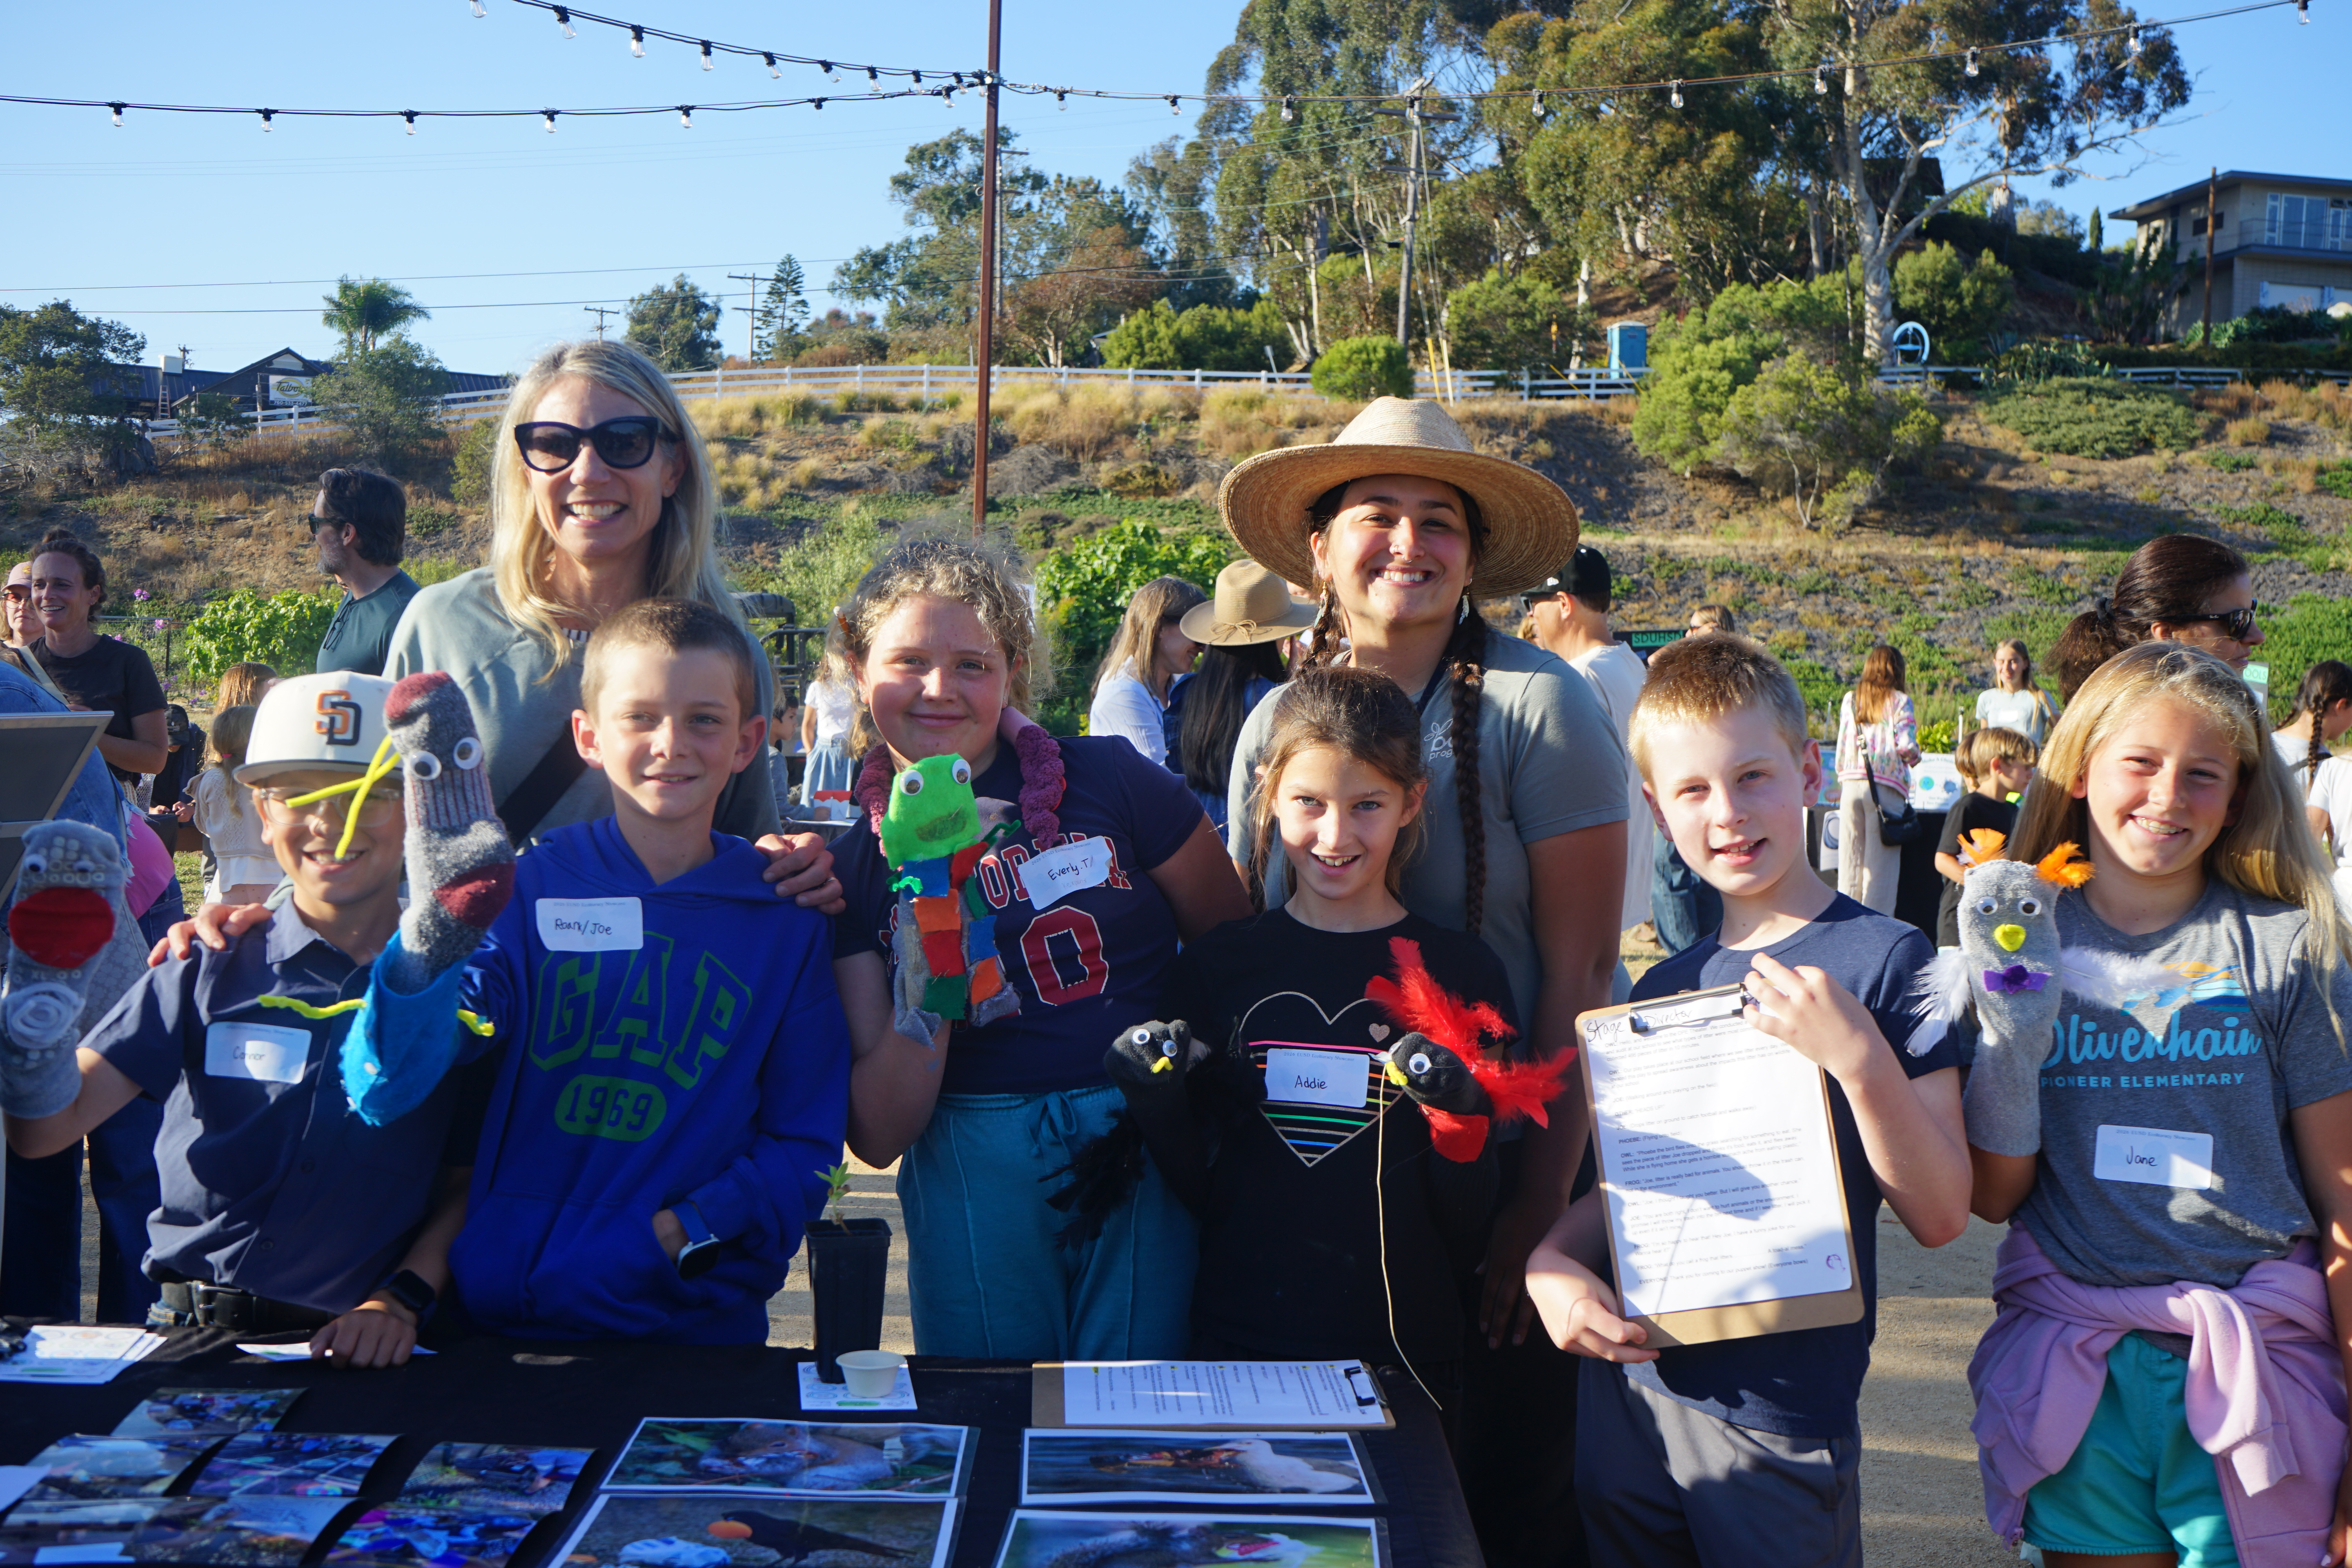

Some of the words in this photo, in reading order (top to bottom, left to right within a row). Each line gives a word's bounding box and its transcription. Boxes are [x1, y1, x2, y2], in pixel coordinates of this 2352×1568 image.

[1634, 630, 1682, 644] SDUHSD
[315, 690, 362, 746] SD
[529, 931, 753, 1090] GAP
[1588, 1020, 1624, 1042] Stage
[1644, 1009, 1692, 1027] Director
[2040, 1010, 2261, 1069] Olivenhain
[1294, 1075, 1328, 1089] Addie
[2041, 1076, 2111, 1088] PIONEER
[2121, 1073, 2245, 1087] ELEMENTARY
[564, 1083, 653, 1131] 1969
[2126, 1145, 2158, 1167] Jane
